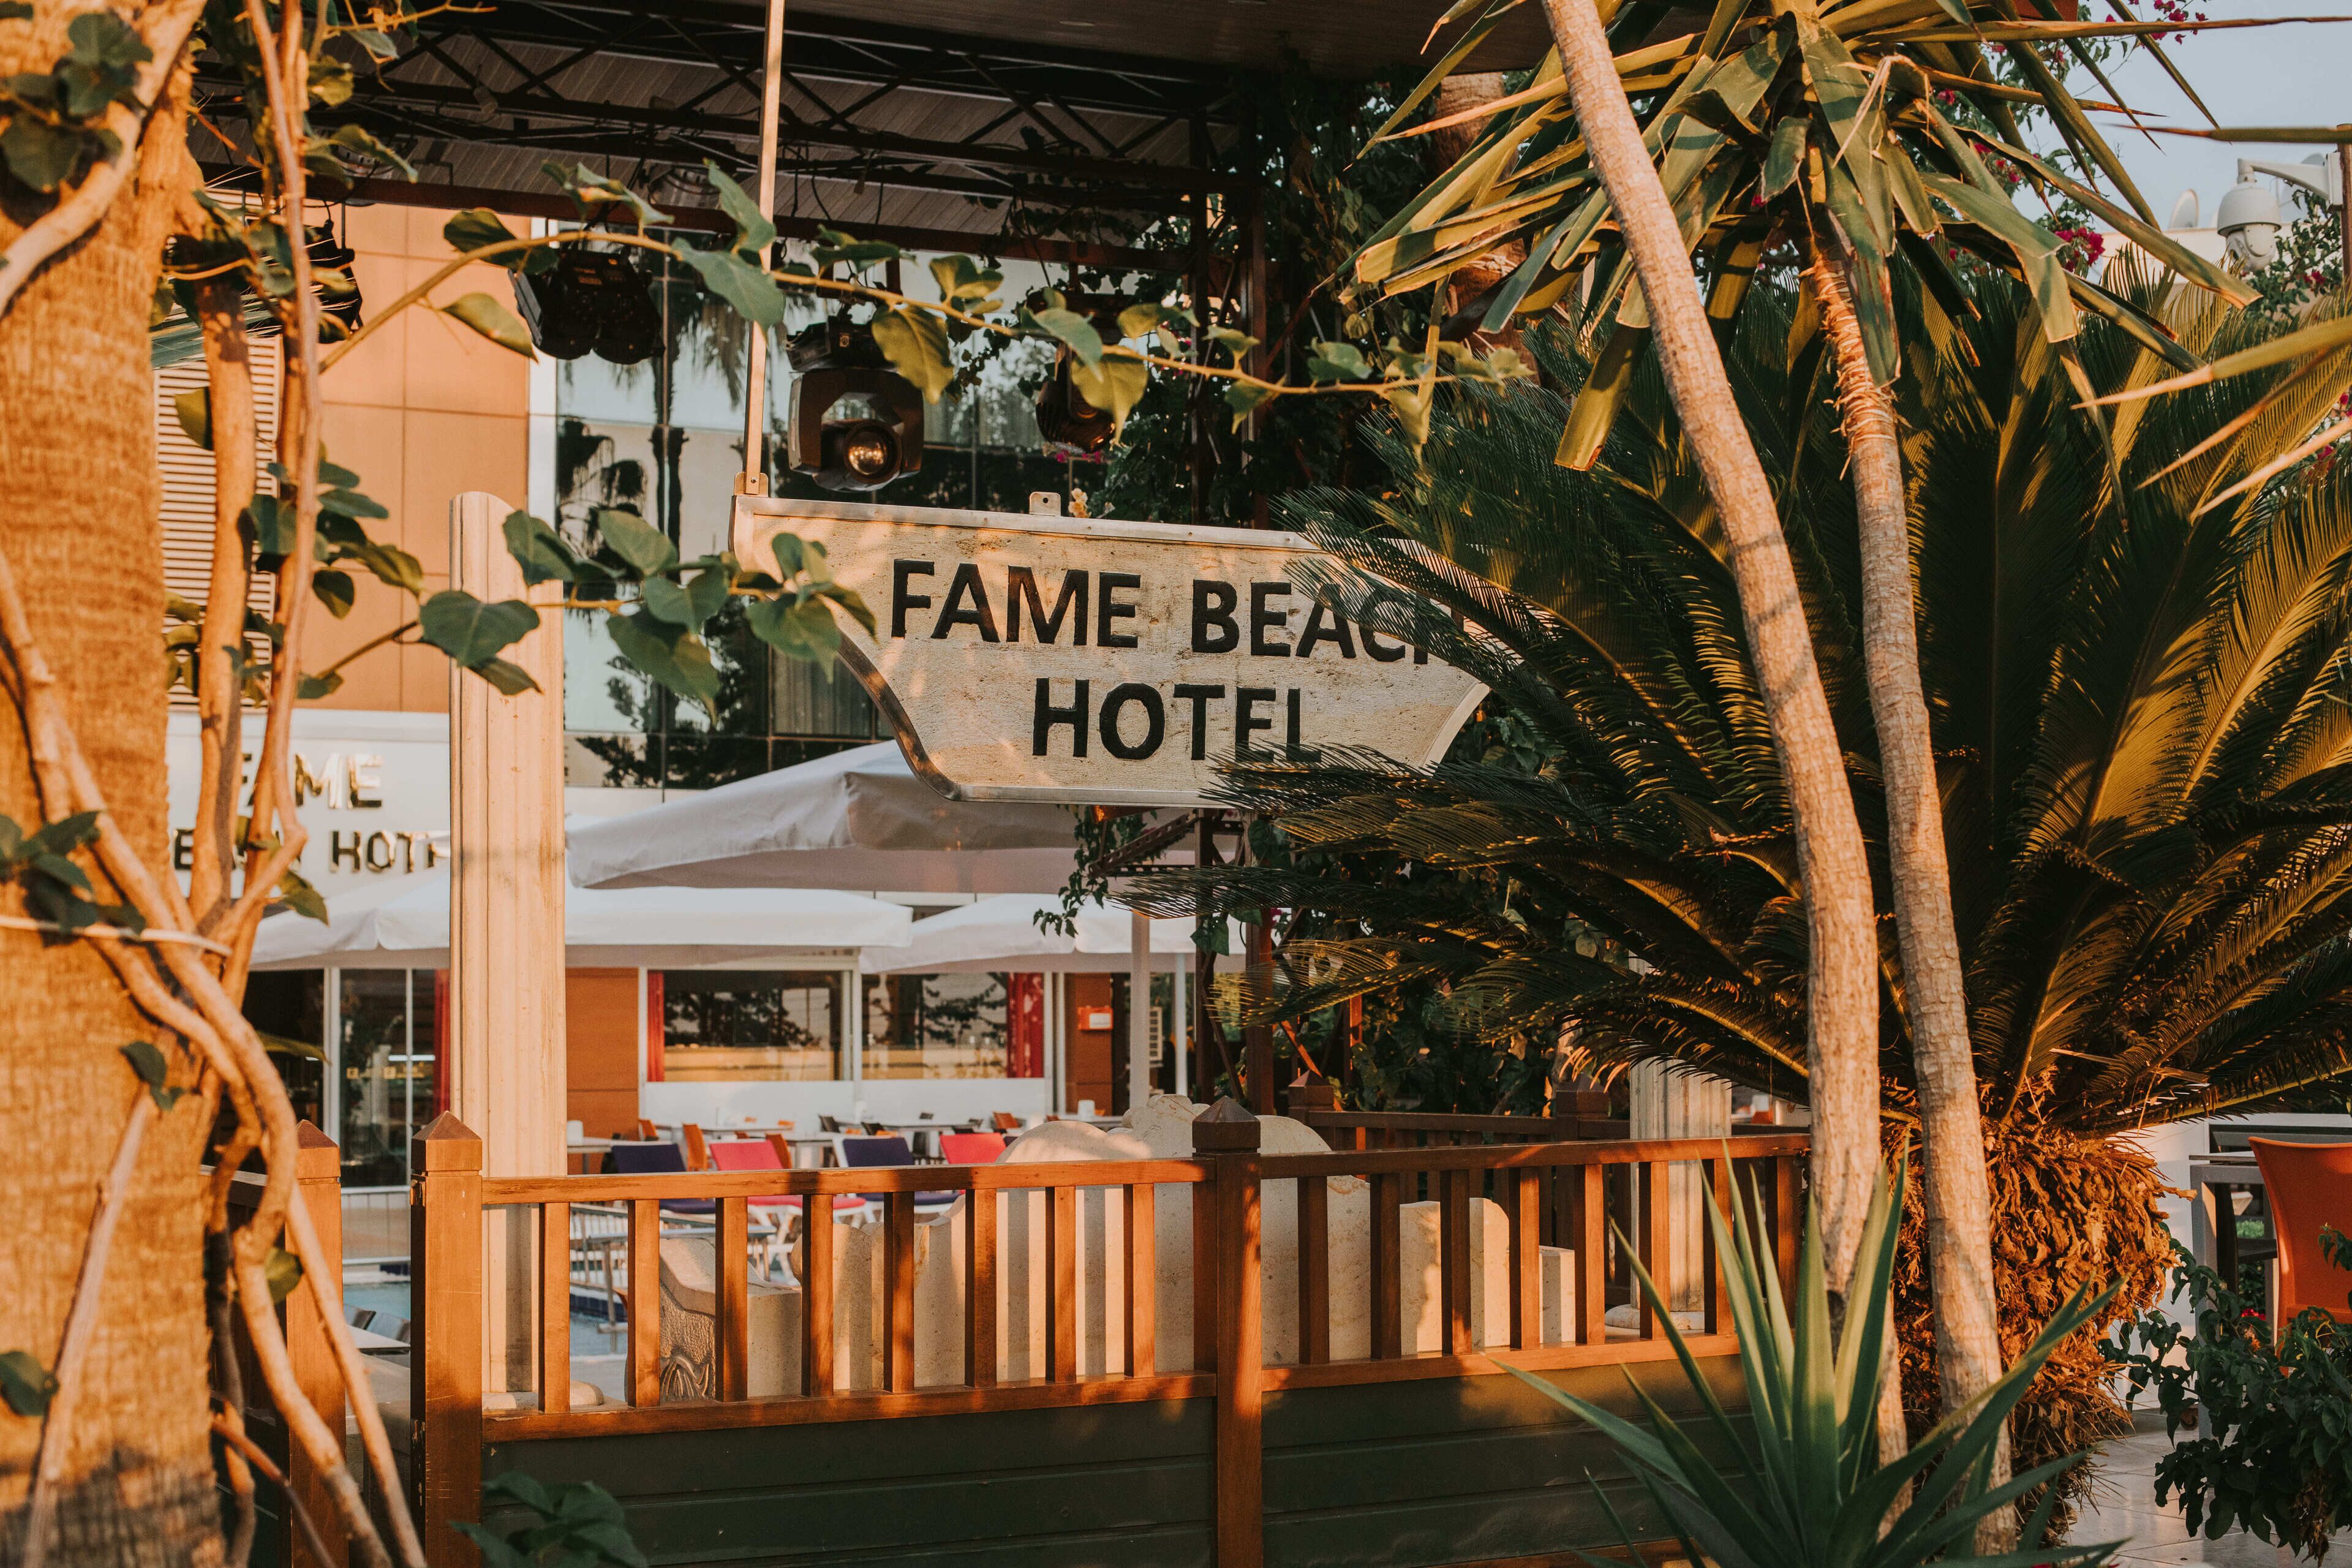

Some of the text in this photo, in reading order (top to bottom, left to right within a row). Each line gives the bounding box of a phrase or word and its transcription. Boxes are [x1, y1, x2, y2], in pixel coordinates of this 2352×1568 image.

[891, 558, 1141, 649] FAME
[1032, 677, 1322, 763] HOTEL
[241, 753, 383, 809] ME
